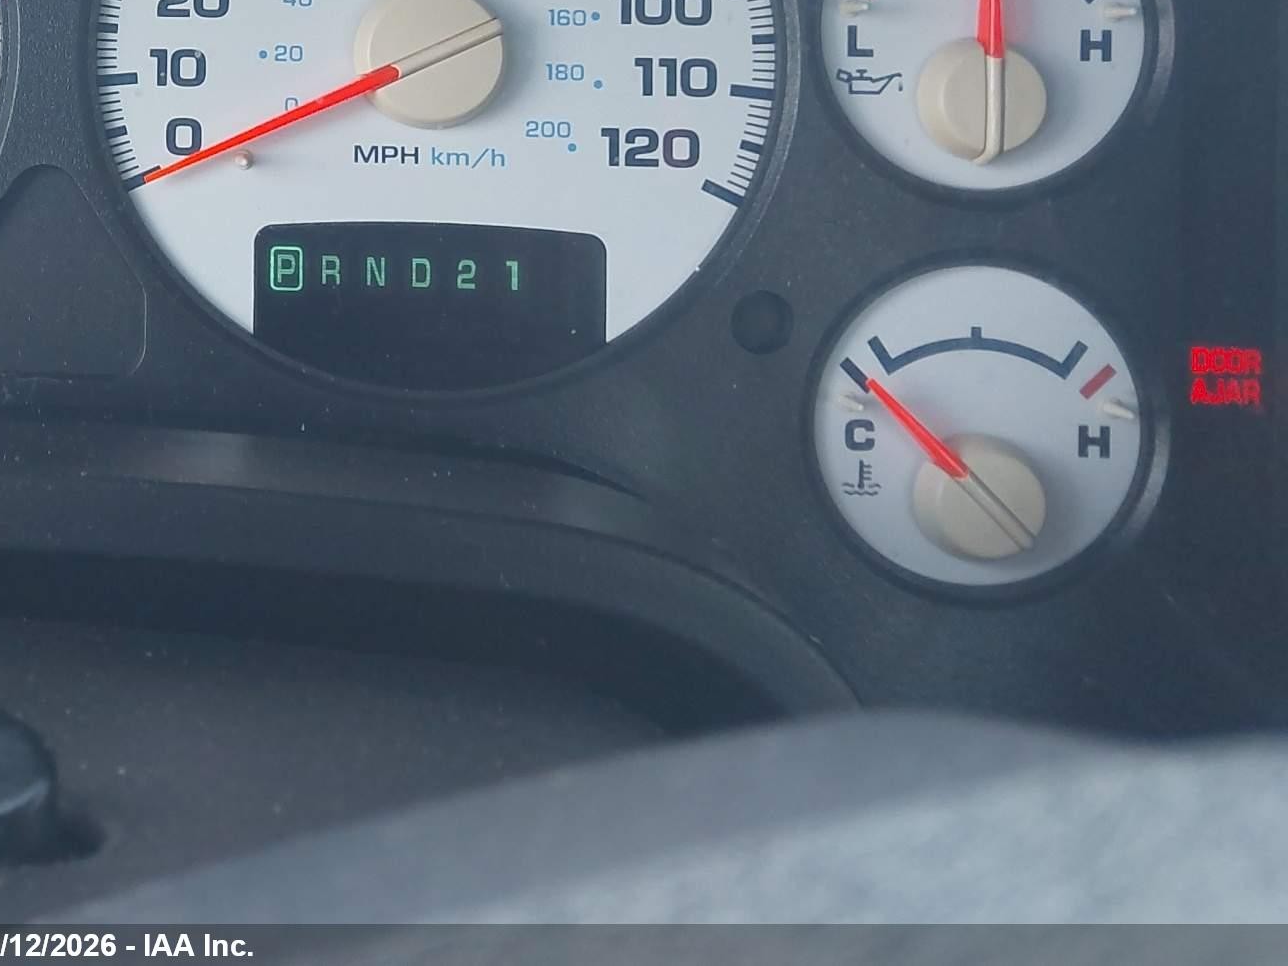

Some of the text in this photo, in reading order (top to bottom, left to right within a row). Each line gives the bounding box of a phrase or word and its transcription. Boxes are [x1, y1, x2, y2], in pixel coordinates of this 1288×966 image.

[548, 8, 586, 26] 160
[274, 45, 303, 62] 20
[848, 25, 873, 58] L
[1081, 30, 1112, 62] H
[150, 49, 206, 87] 10
[546, 64, 584, 82] 180
[635, 57, 716, 97] 110
[166, 117, 202, 155] 0
[525, 121, 571, 138] 200
[353, 145, 505, 168] MPH km/h
[601, 127, 699, 168] 120
[278, 254, 519, 290] P R N D 2 1
[1191, 347, 1261, 373] DOOR
[1191, 378, 1261, 405] AJAR
[845, 420, 874, 452] C
[1078, 425, 1110, 458] H
